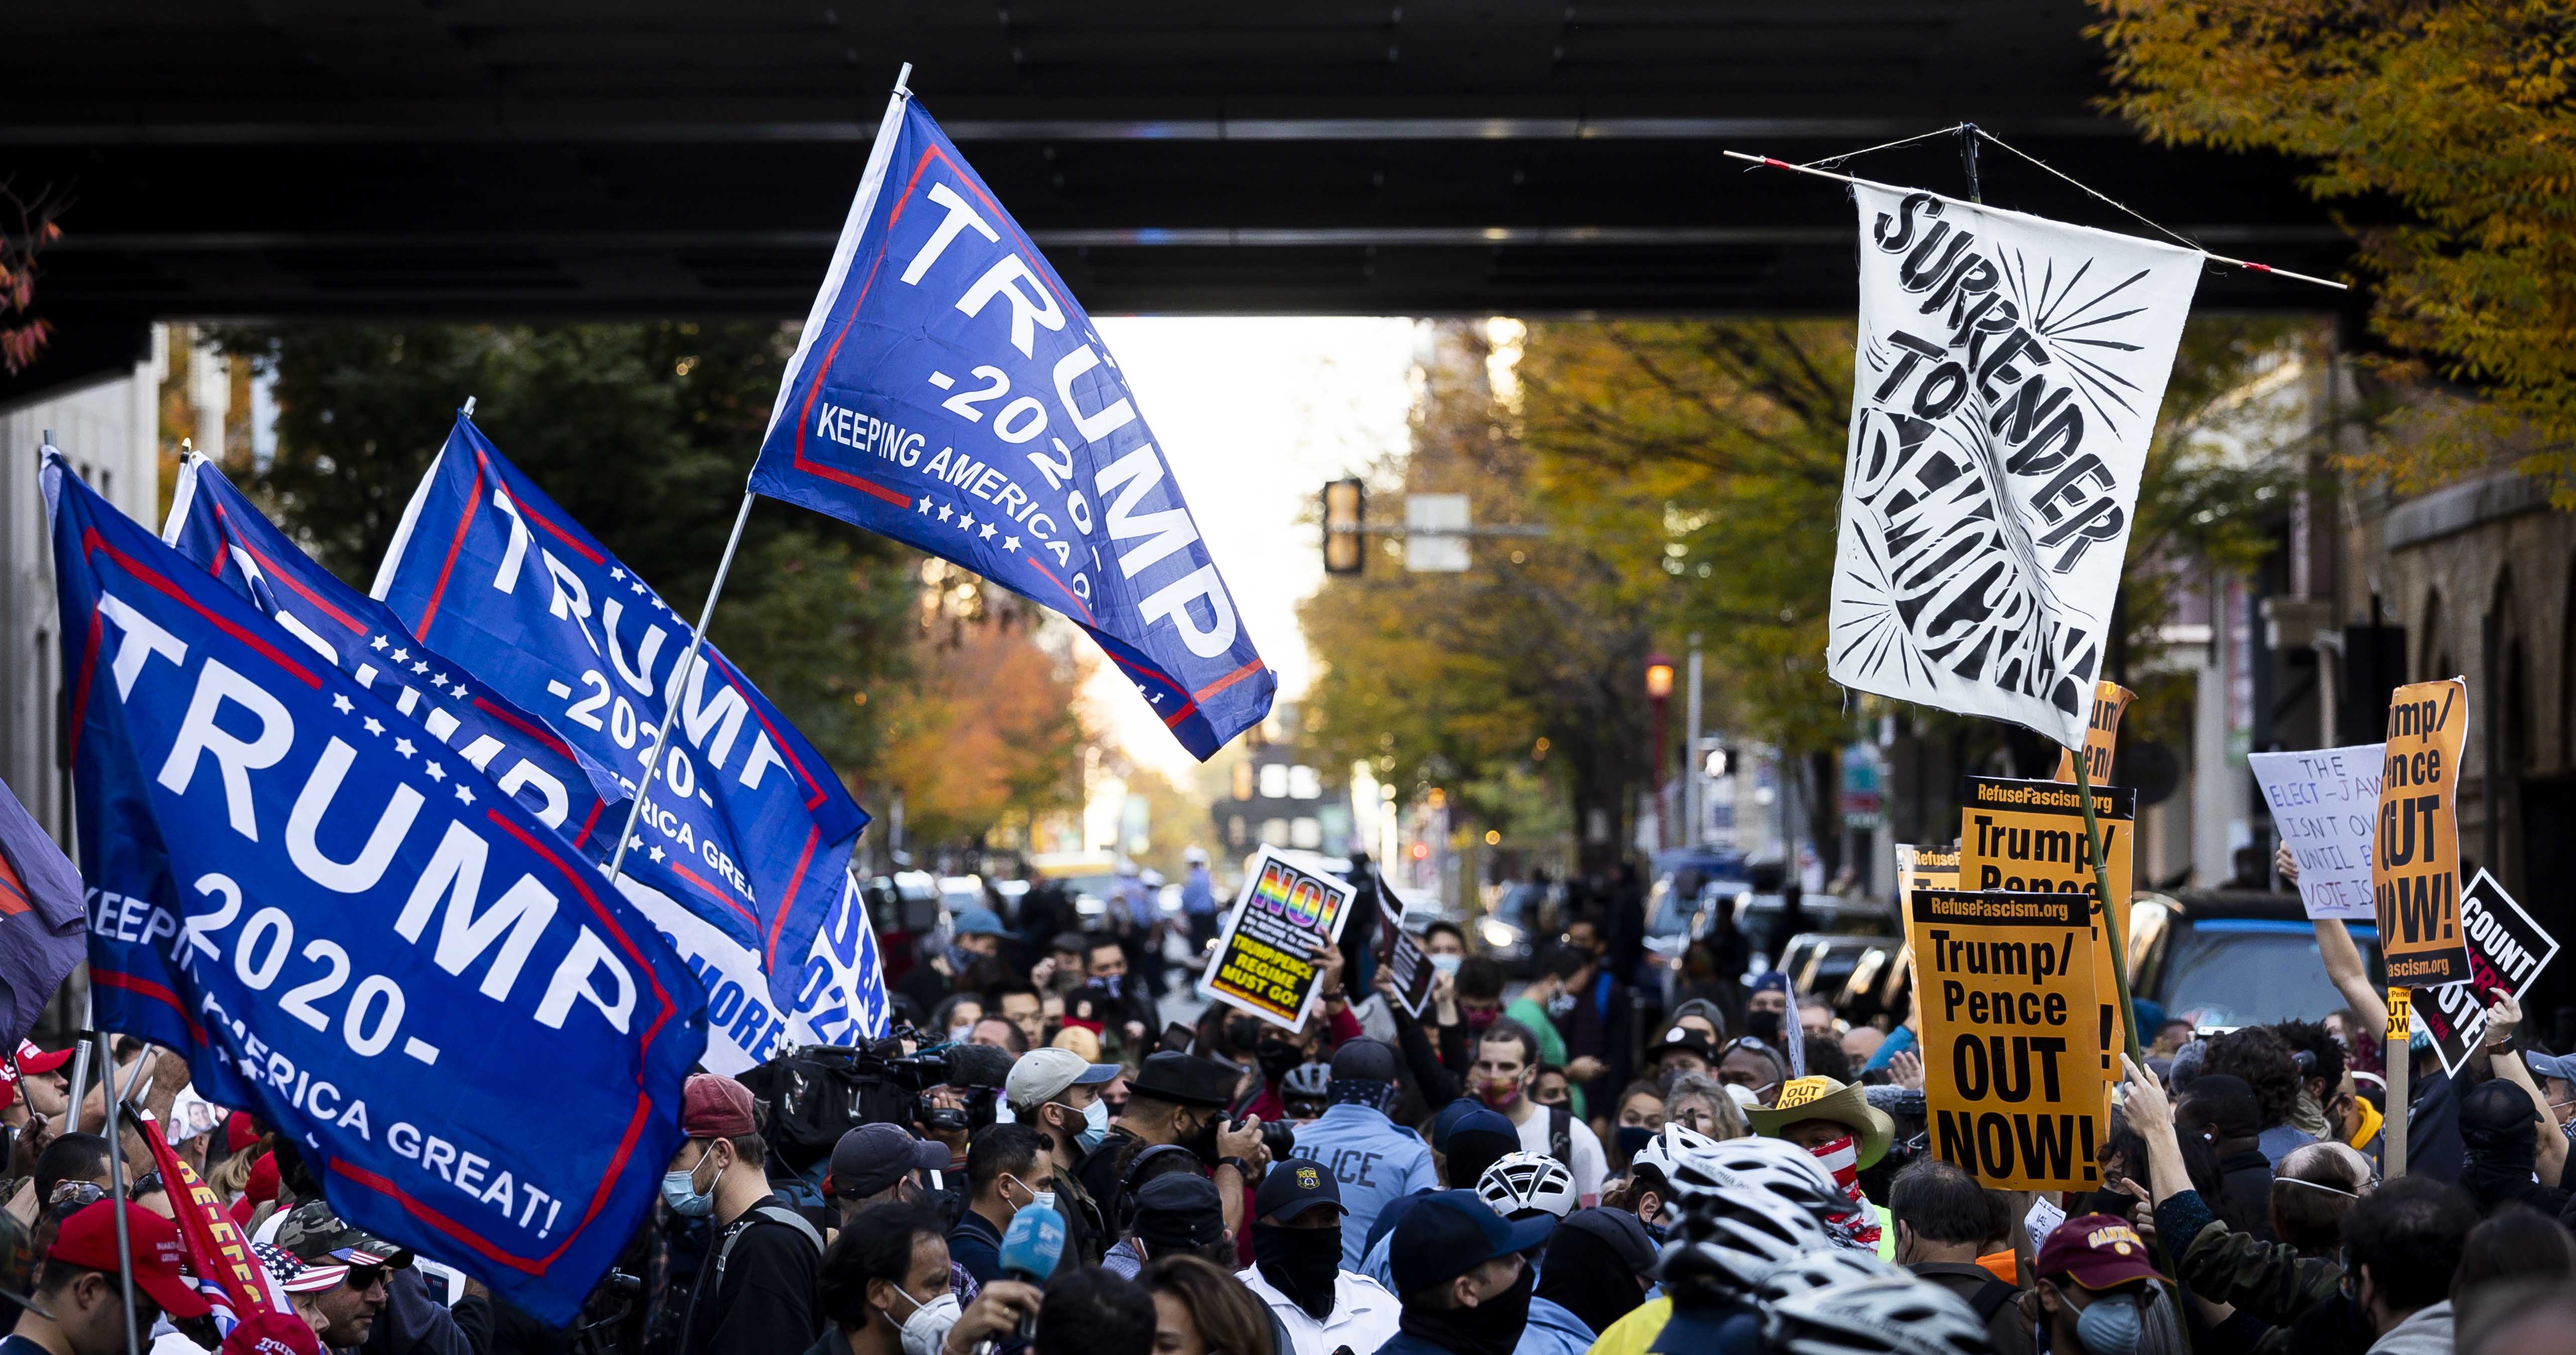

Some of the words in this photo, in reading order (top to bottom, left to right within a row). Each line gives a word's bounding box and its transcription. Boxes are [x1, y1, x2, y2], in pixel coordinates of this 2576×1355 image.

[1872, 330, 1970, 421] TO
[1874, 191, 2125, 574] SURRENDER
[900, 182, 1237, 658] TRUMP
[817, 402, 925, 467] KEEPING
[922, 447, 1070, 568] AMERICA
[2298, 756, 2345, 779] THE
[98, 590, 638, 1034] TRUMP
[2285, 816, 2336, 839] ISN'T
[2381, 794, 2439, 871] OUT
[2296, 844, 2354, 870] UNTIL
[1250, 860, 1342, 934] NO!
[1931, 897, 2068, 921] RefuseFascism.org
[2301, 881, 2350, 907] VOTE
[1929, 930, 2075, 985] Trump/
[2461, 897, 2537, 982] COUNT
[1221, 964, 1268, 994] MUST
[1268, 983, 1300, 1008] GO!
[1235, 953, 1298, 990] REGIME
[2388, 958, 2450, 978] ascism.org
[686, 953, 787, 1062] MORE
[1943, 981, 2068, 1025] Pence
[2388, 1001, 2408, 1017] UT
[2388, 1017, 2409, 1033] OW
[2426, 984, 2488, 1048] OTE
[1787, 1086, 1820, 1098] OUT
[1952, 1033, 2067, 1104] OUT
[1292, 1146, 1383, 1188] ICE
[1937, 1109, 2098, 1181] NOW!
[386, 1123, 562, 1239] GREAT!
